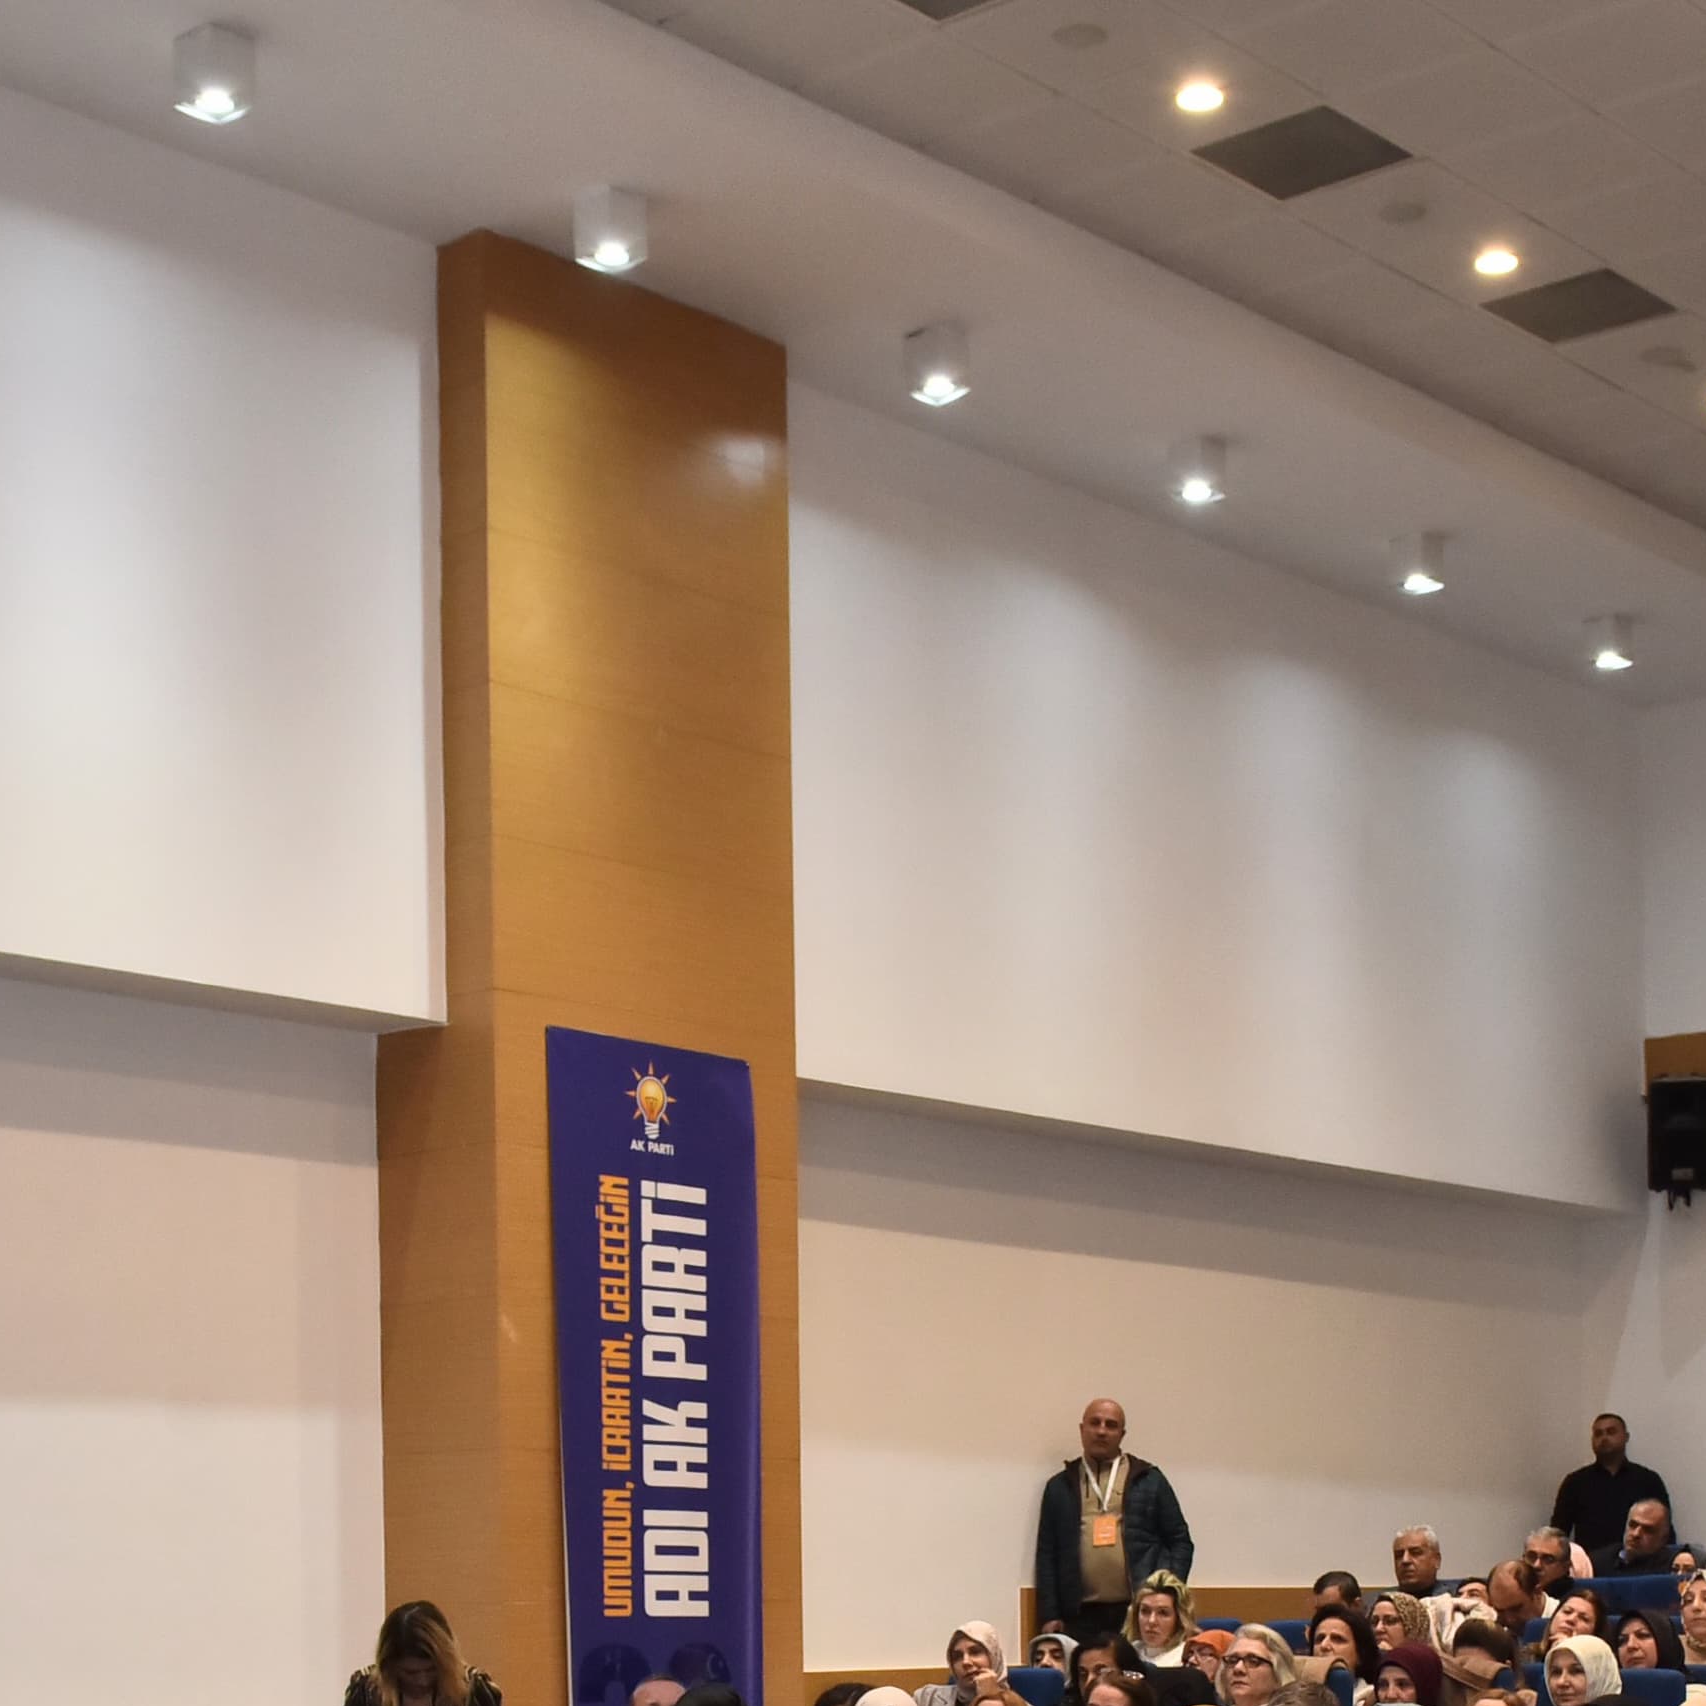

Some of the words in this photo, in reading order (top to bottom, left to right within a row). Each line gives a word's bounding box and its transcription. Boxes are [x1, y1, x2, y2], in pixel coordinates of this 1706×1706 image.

[629, 1138, 646, 1152] AK
[595, 1173, 631, 1323] GELECEĞİN
[639, 1178, 708, 1382] PARTİ
[600, 1332, 634, 1472] İCRAATİN,
[641, 1398, 709, 1490] AK
[602, 1480, 635, 1618] UMUDUN,
[642, 1508, 710, 1618] ADI
